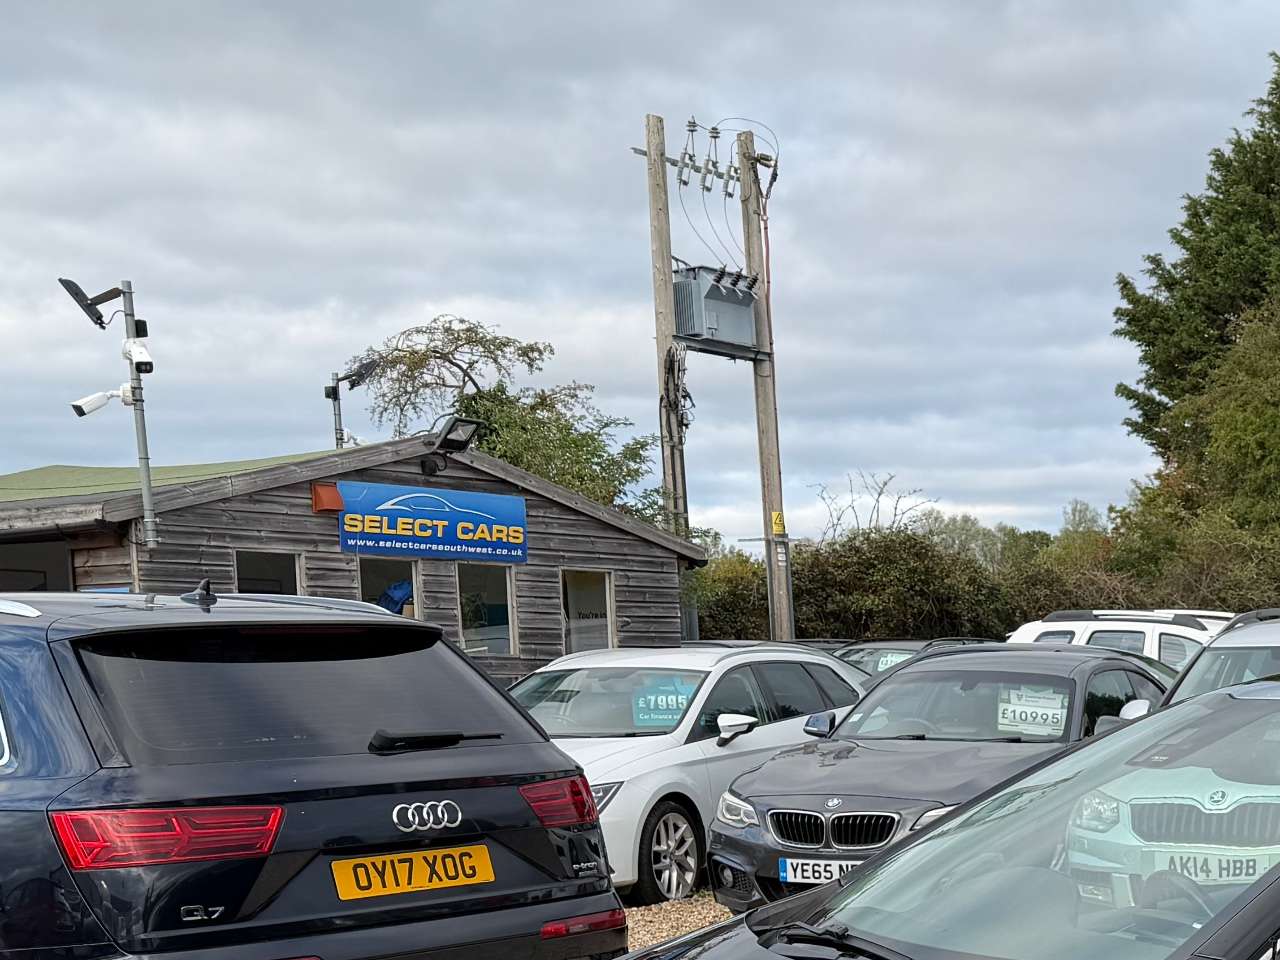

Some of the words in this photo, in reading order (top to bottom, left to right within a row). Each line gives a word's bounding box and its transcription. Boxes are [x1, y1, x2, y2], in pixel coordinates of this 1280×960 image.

[344, 514, 449, 538] SELECT
[457, 522, 524, 544] CARS
[347, 538, 523, 556] www.selectcarssouthwest.co.uk
[1001, 708, 1060, 724] £10995
[352, 858, 414, 891] OY17
[422, 851, 477, 883] XOG
[790, 862, 833, 880] YE65
[838, 863, 858, 878] N
[1168, 856, 1212, 878] AK14
[1218, 858, 1257, 878] HBB
[181, 905, 225, 920] Q7
